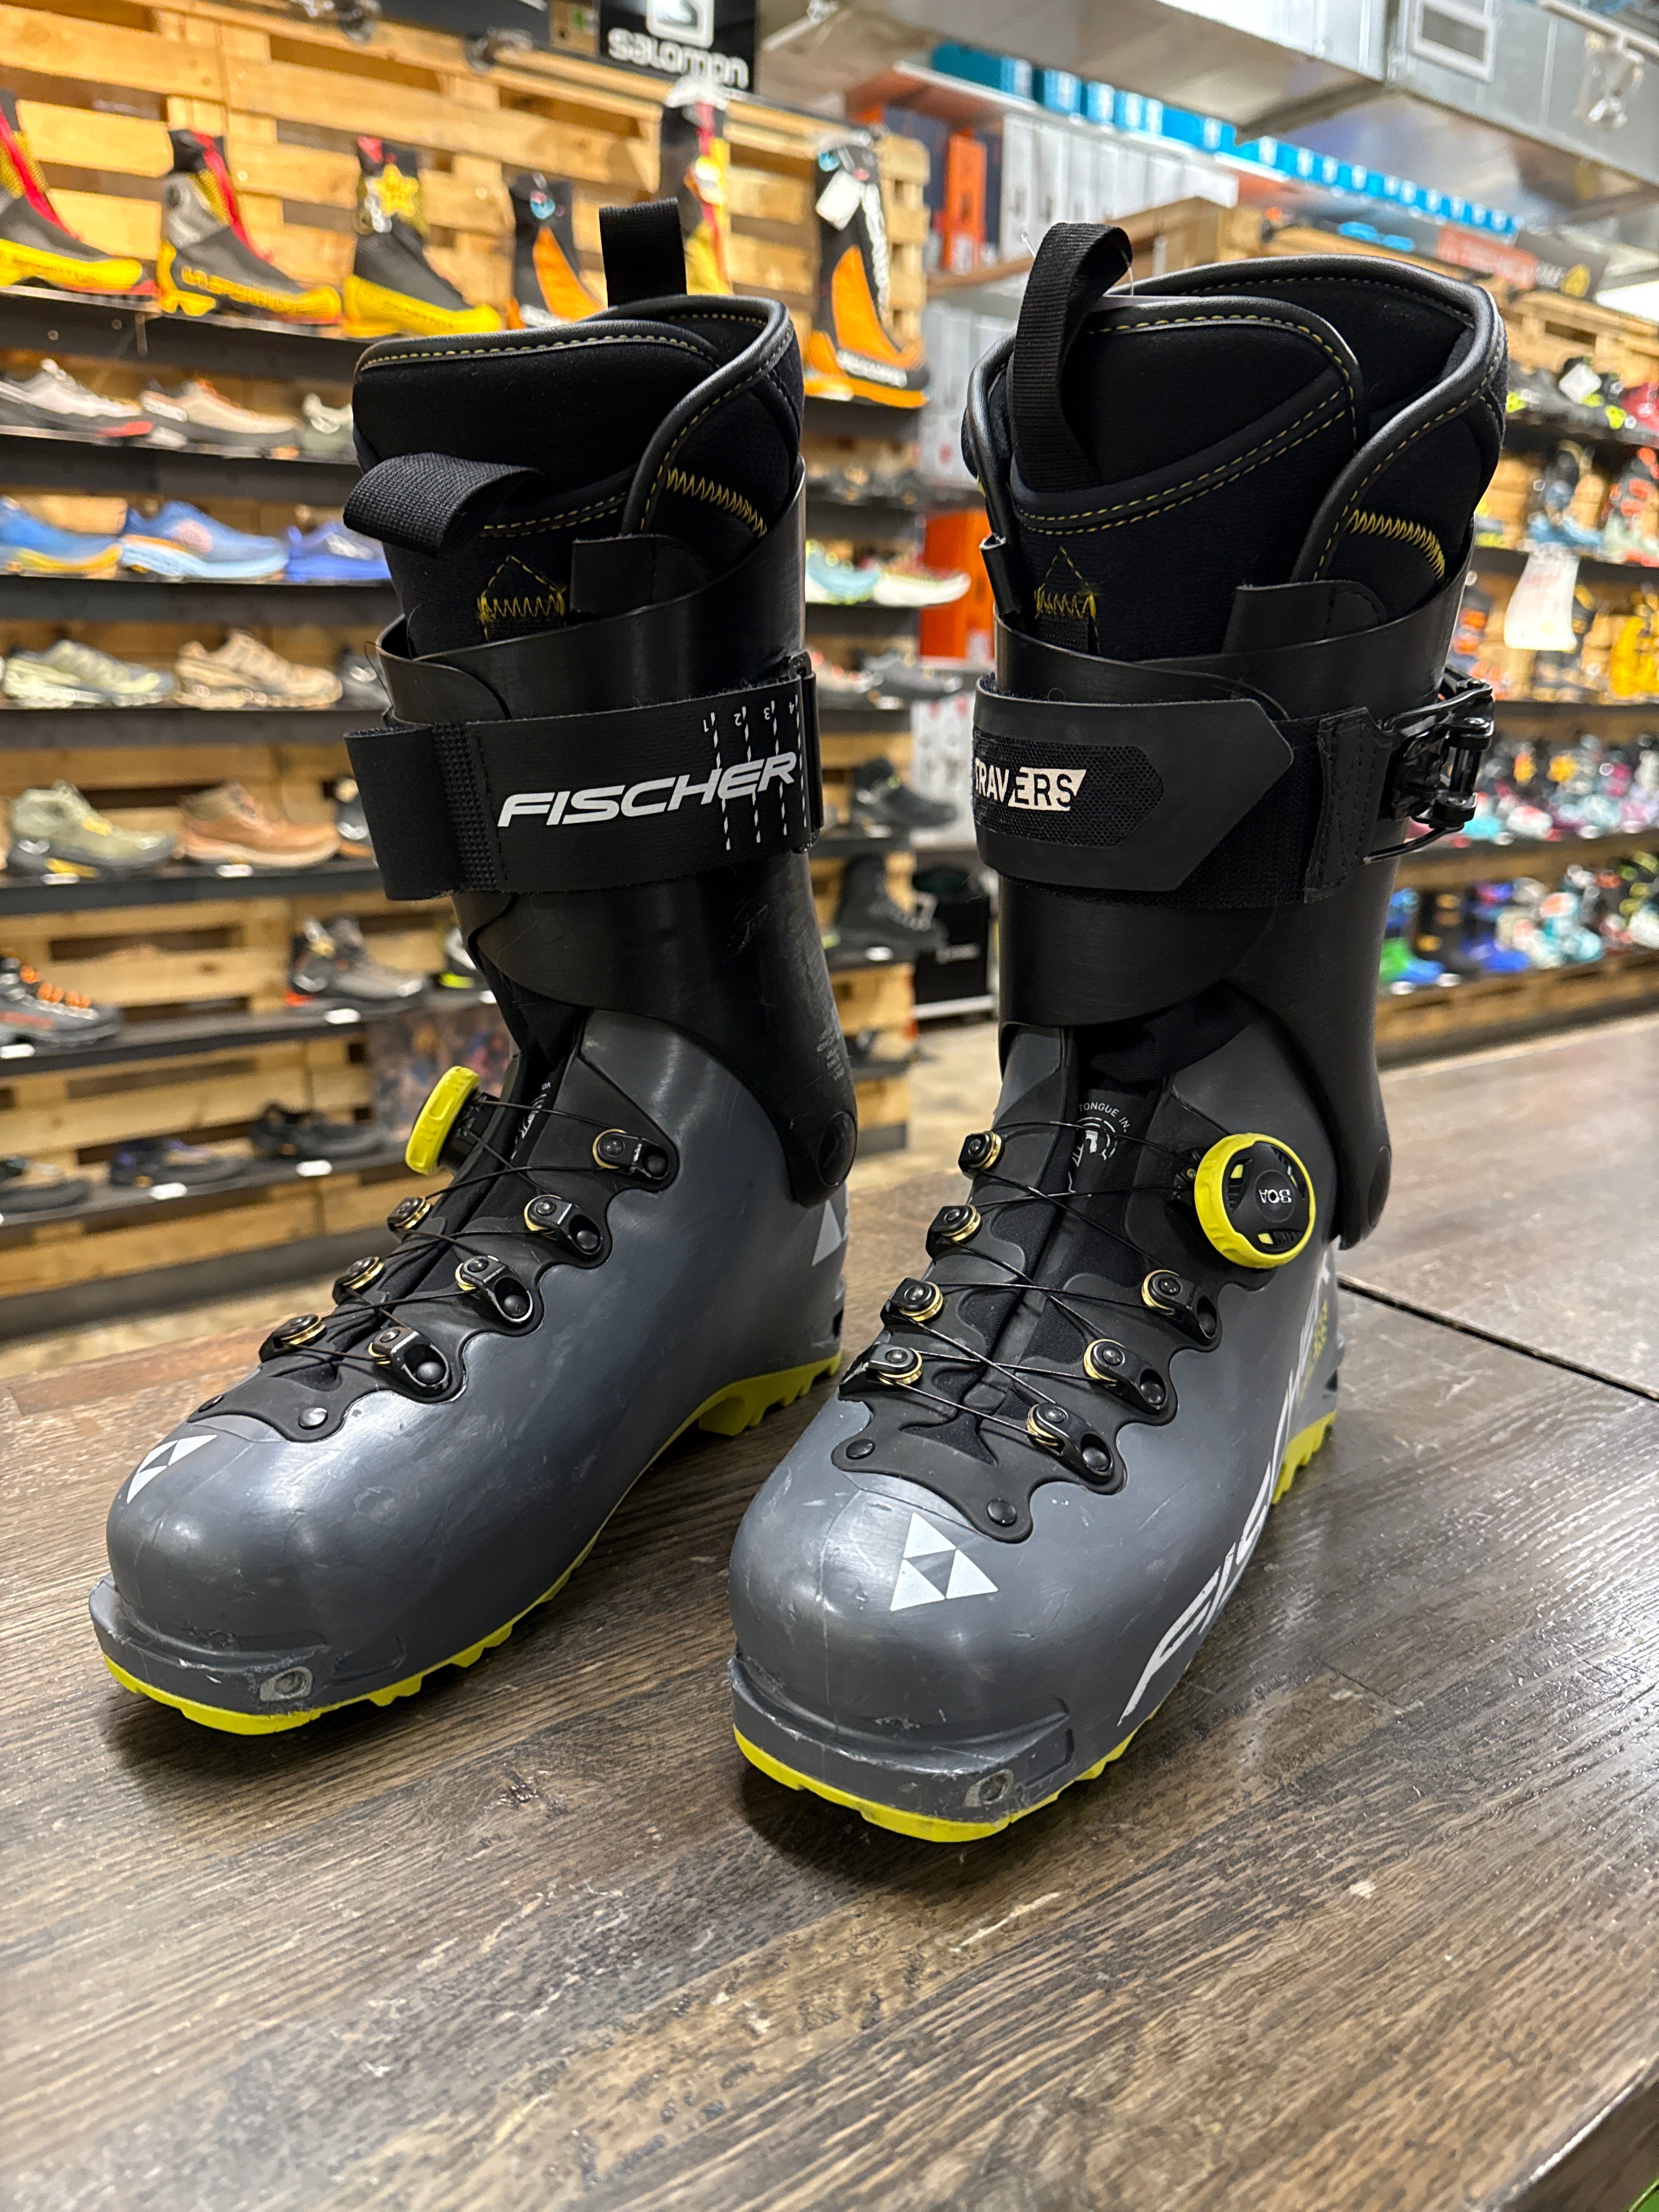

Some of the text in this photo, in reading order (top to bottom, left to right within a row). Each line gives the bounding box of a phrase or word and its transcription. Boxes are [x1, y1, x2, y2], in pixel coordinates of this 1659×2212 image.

[733, 713, 742, 726] 2
[763, 707, 771, 720] 3
[788, 702, 795, 715] 4
[497, 751, 797, 827] FISCHER
[1079, 1102, 1120, 1118] TONGUE
[1258, 1189, 1292, 1204] BOA
